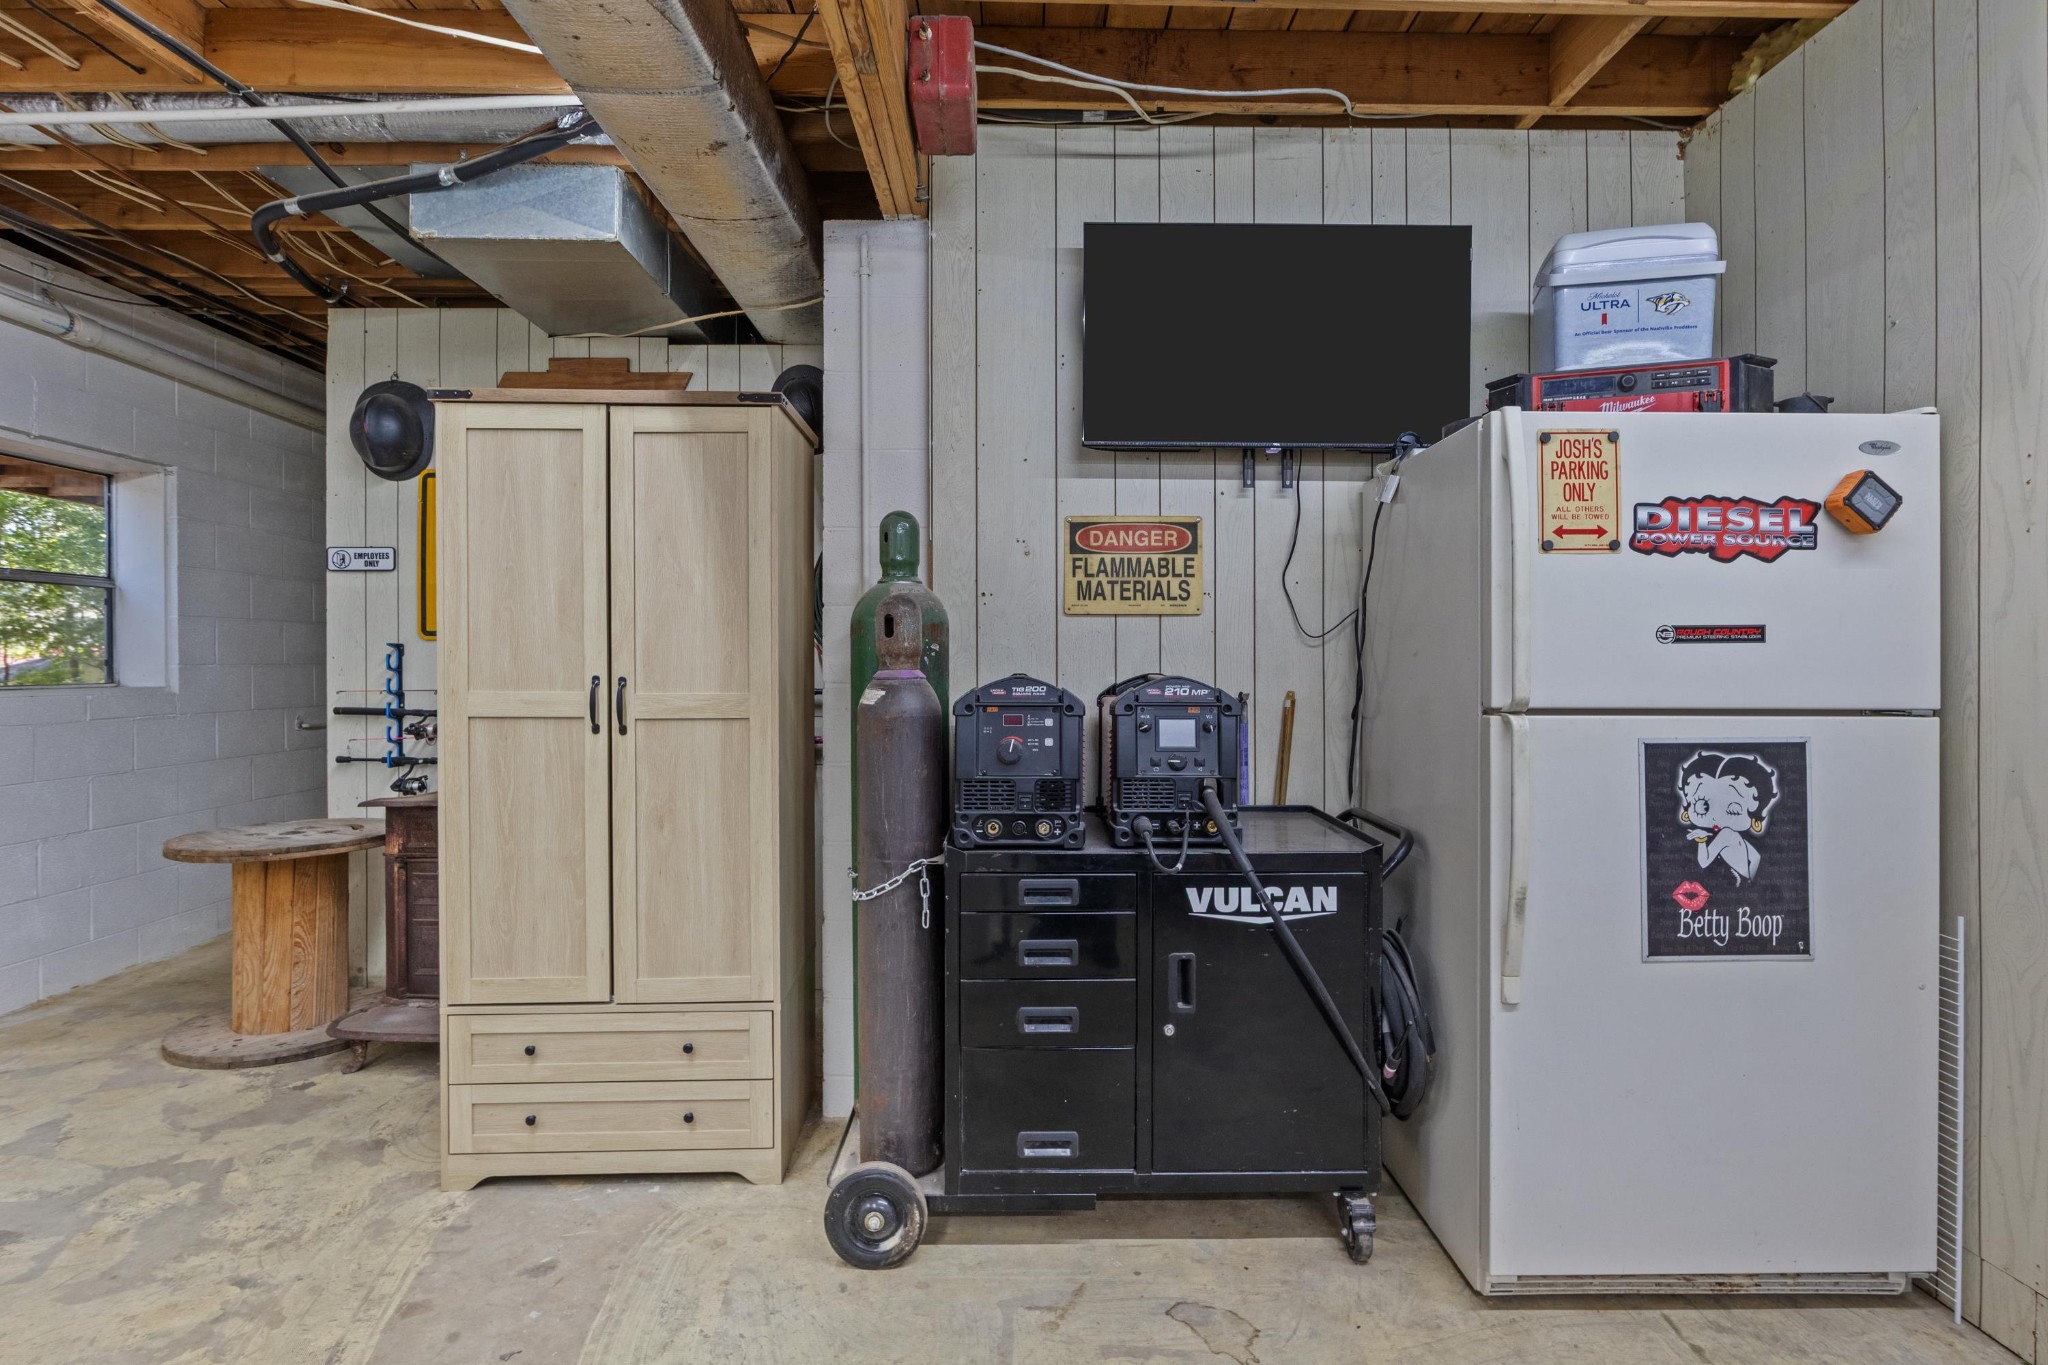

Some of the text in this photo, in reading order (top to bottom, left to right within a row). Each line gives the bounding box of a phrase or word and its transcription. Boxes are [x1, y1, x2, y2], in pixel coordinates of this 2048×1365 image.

[1581, 299, 1631, 311] ULTRA
[1600, 395, 1656, 412] Milwaukee
[1555, 437, 1602, 459] JOSH'S
[1551, 460, 1608, 480] PARKING
[1563, 482, 1596, 502] ONLY
[1636, 505, 1815, 534] DIESEL
[1089, 530, 1178, 547] DANGER
[1635, 532, 1815, 548] POWER SOURCE
[354, 552, 390, 560] EMPLOYEES
[1072, 557, 1195, 578] FLAMMABLE
[1077, 580, 1191, 601] MATERIALS
[1164, 688, 1190, 696] 210
[1185, 886, 1337, 913] VULCAN
[1677, 906, 1782, 947] Betty Boop
